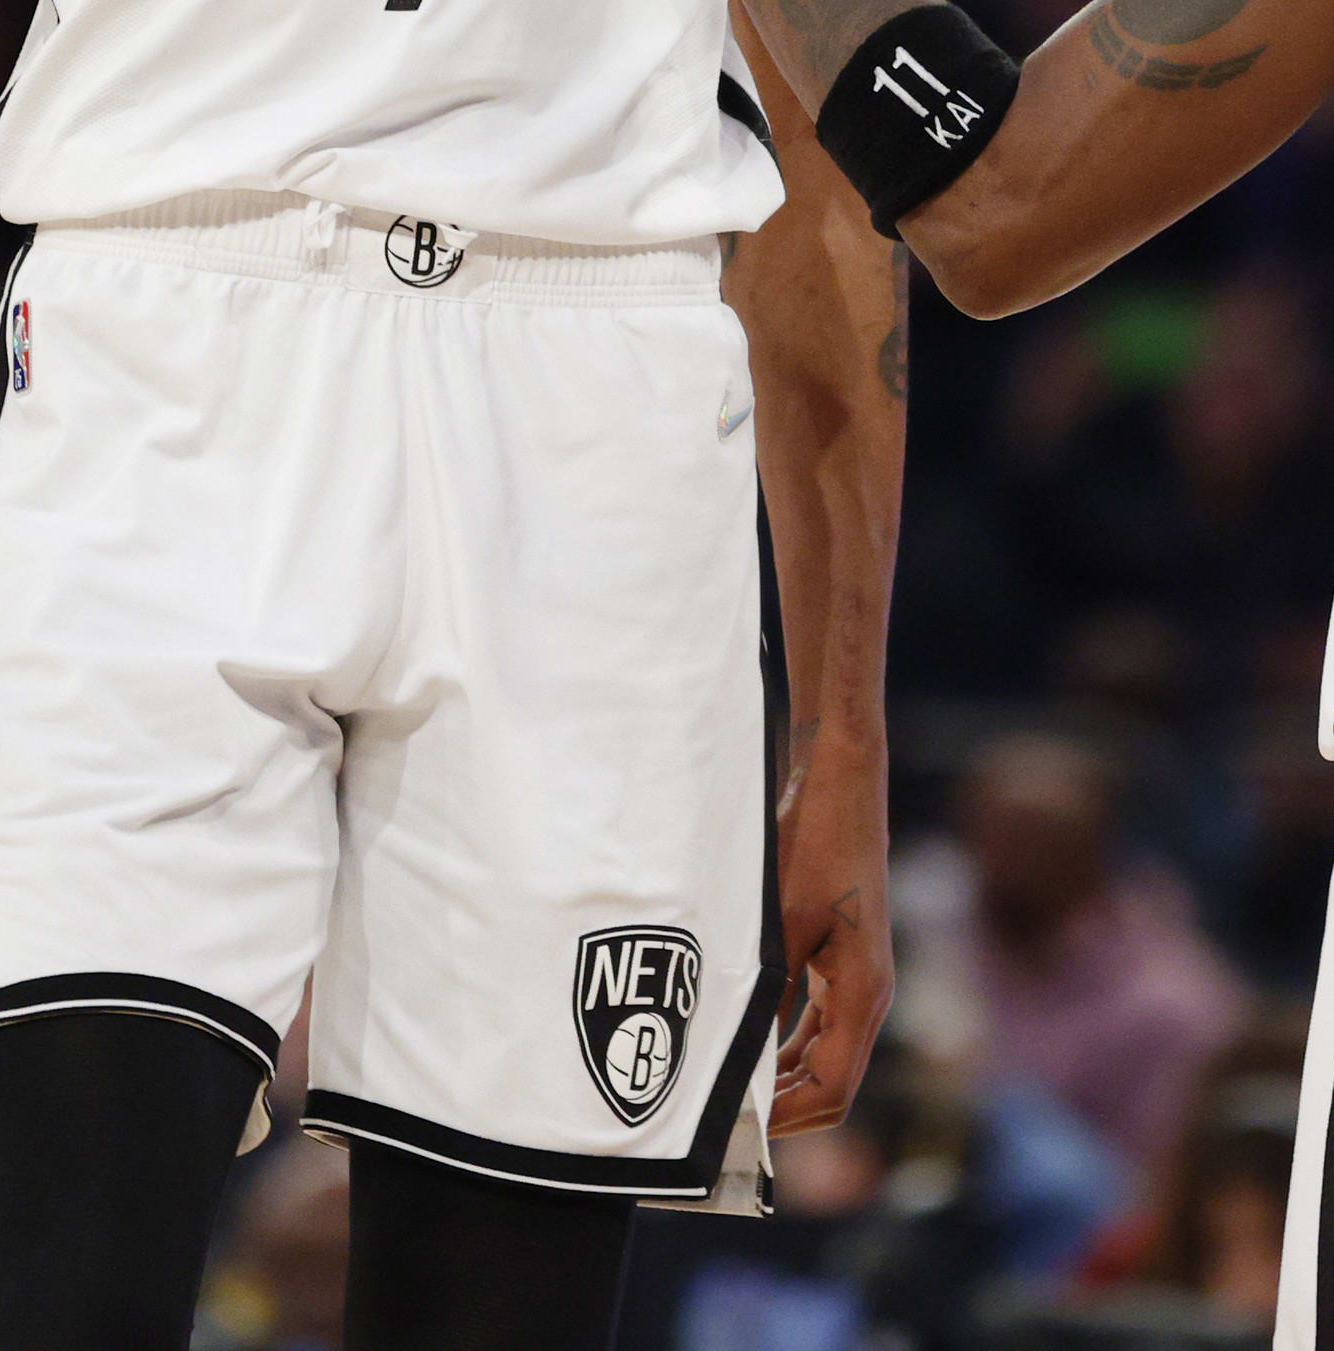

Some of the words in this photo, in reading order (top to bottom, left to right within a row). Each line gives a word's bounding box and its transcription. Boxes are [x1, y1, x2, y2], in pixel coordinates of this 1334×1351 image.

[873, 46, 951, 118] 11
[924, 90, 985, 149] KAI
[411, 221, 437, 276] B
[584, 940, 699, 1019] NETS
[630, 1026, 656, 1091] B
